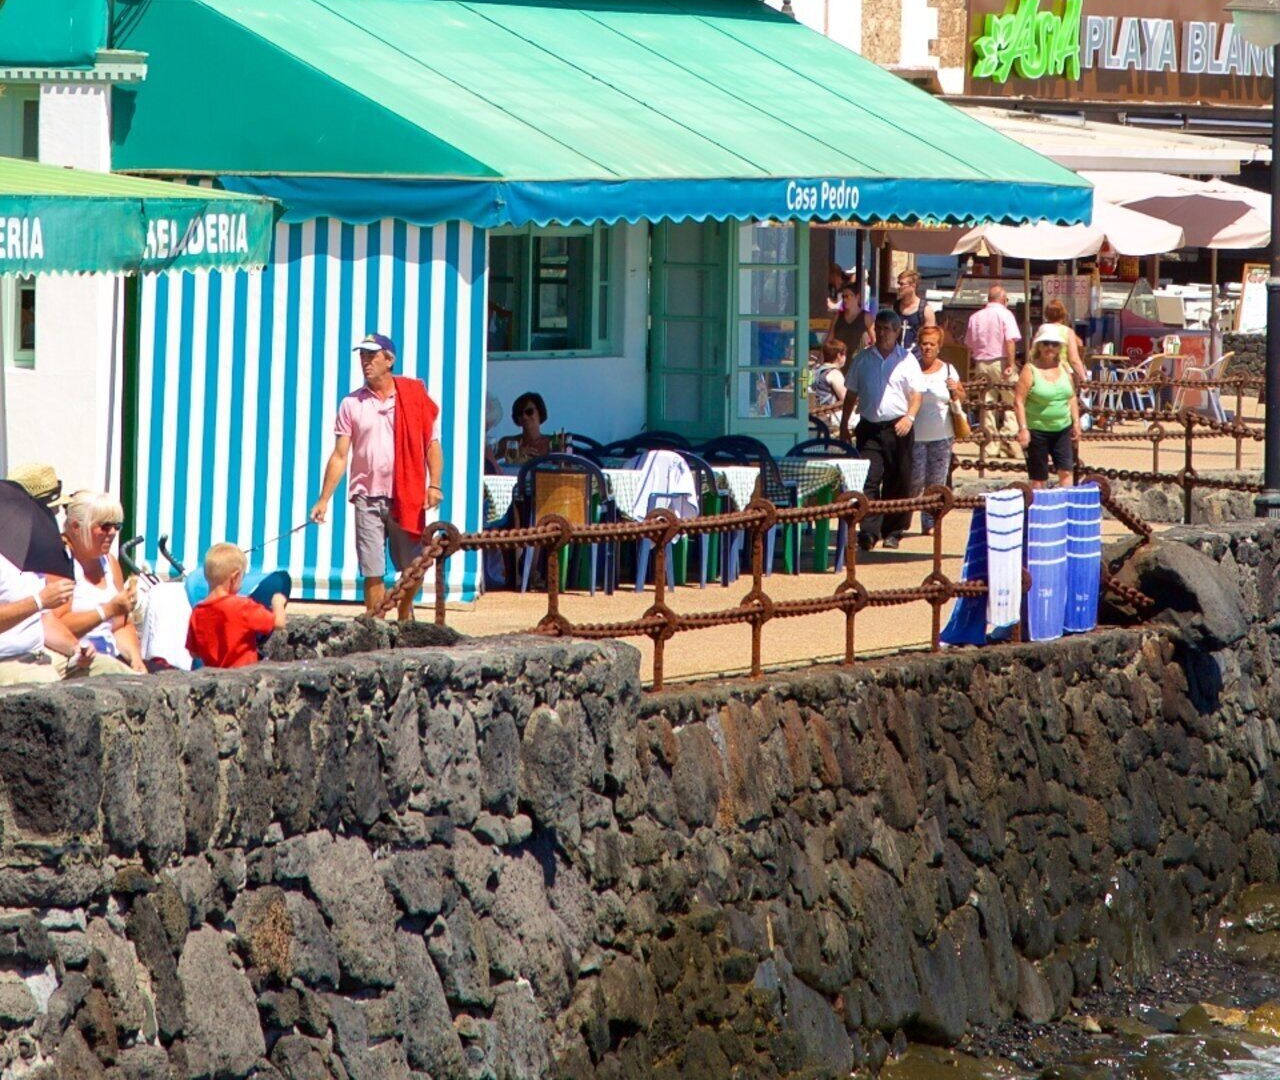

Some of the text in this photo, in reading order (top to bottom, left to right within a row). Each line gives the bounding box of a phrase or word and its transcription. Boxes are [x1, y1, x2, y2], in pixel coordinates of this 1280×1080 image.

[1084, 15, 1178, 72] PLAYA
[787, 180, 859, 210] Casa Pedro
